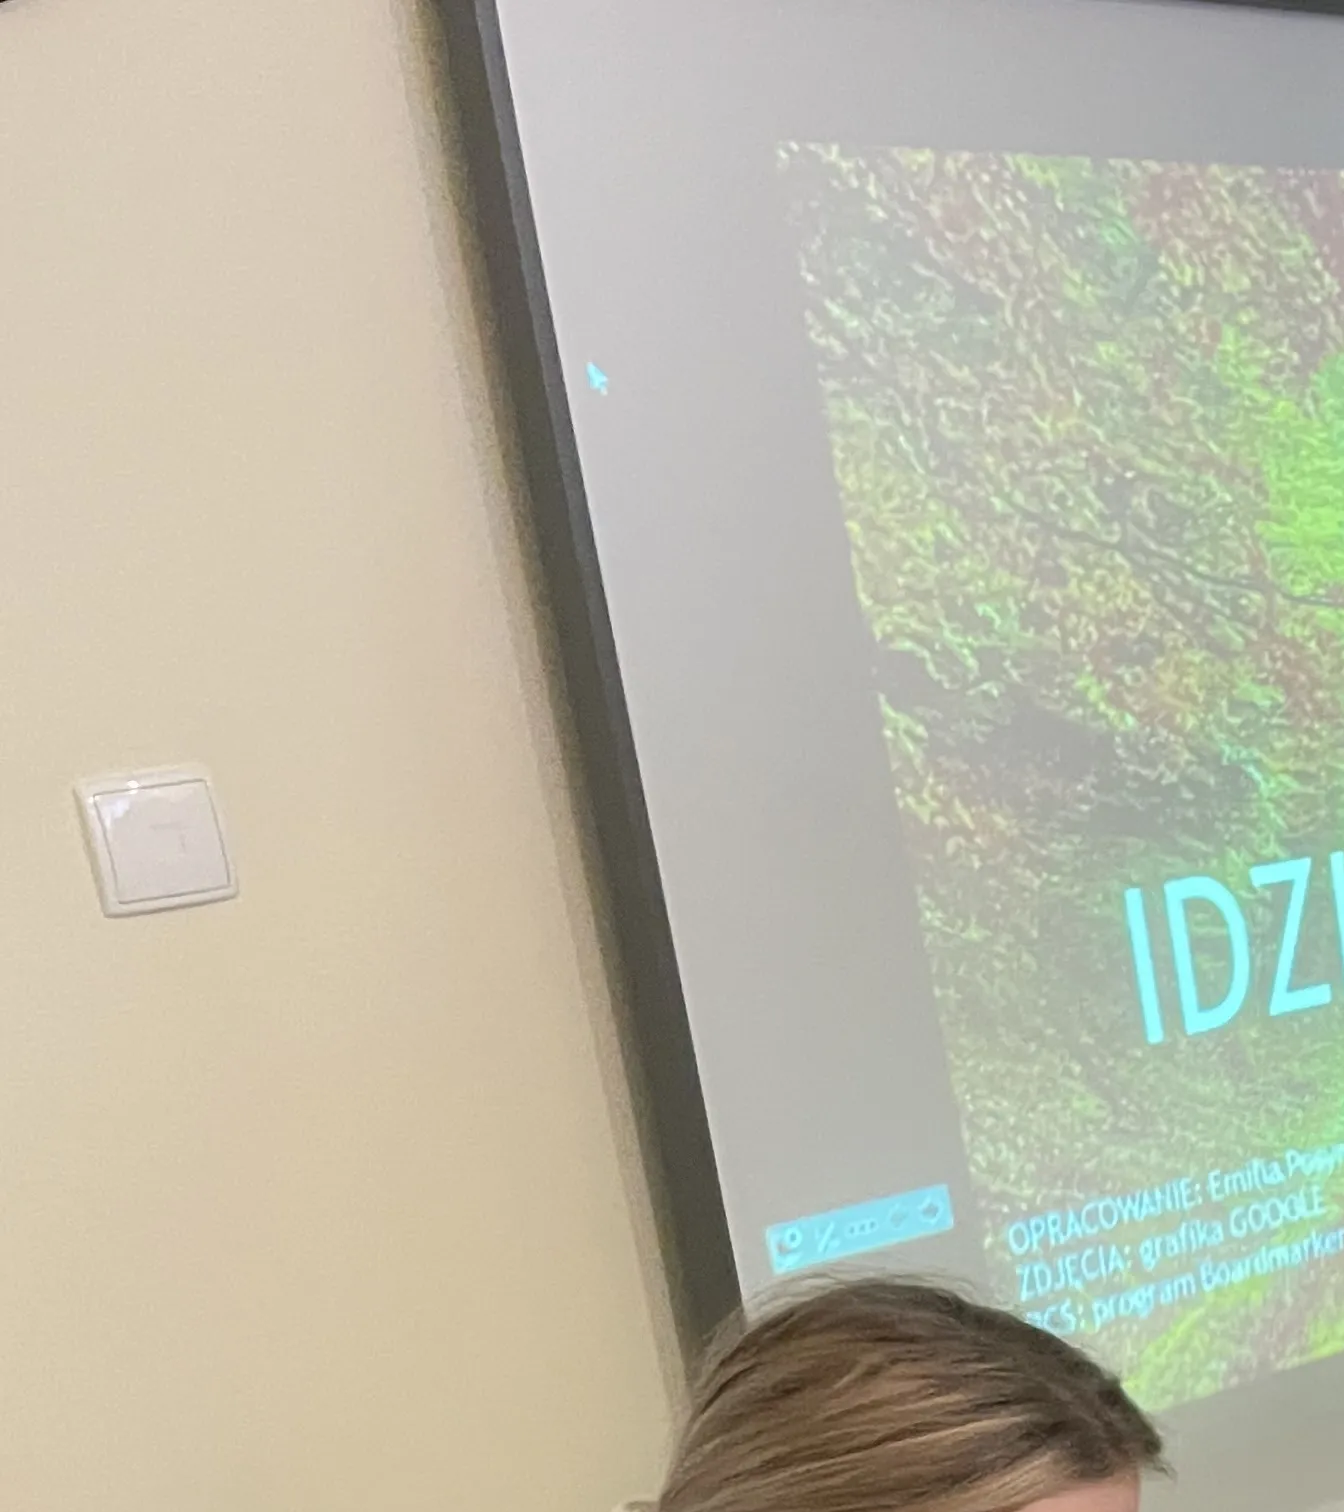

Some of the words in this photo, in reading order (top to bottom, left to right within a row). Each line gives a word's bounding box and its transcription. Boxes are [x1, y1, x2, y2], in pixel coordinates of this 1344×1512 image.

[1008, 1177, 1203, 1255] OPRACOWANIE:
[1208, 1158, 1286, 1202] Emilia
[1138, 1219, 1225, 1271] grafika
[1230, 1185, 1327, 1239] GOOGLE
[1092, 1272, 1197, 1333] program
